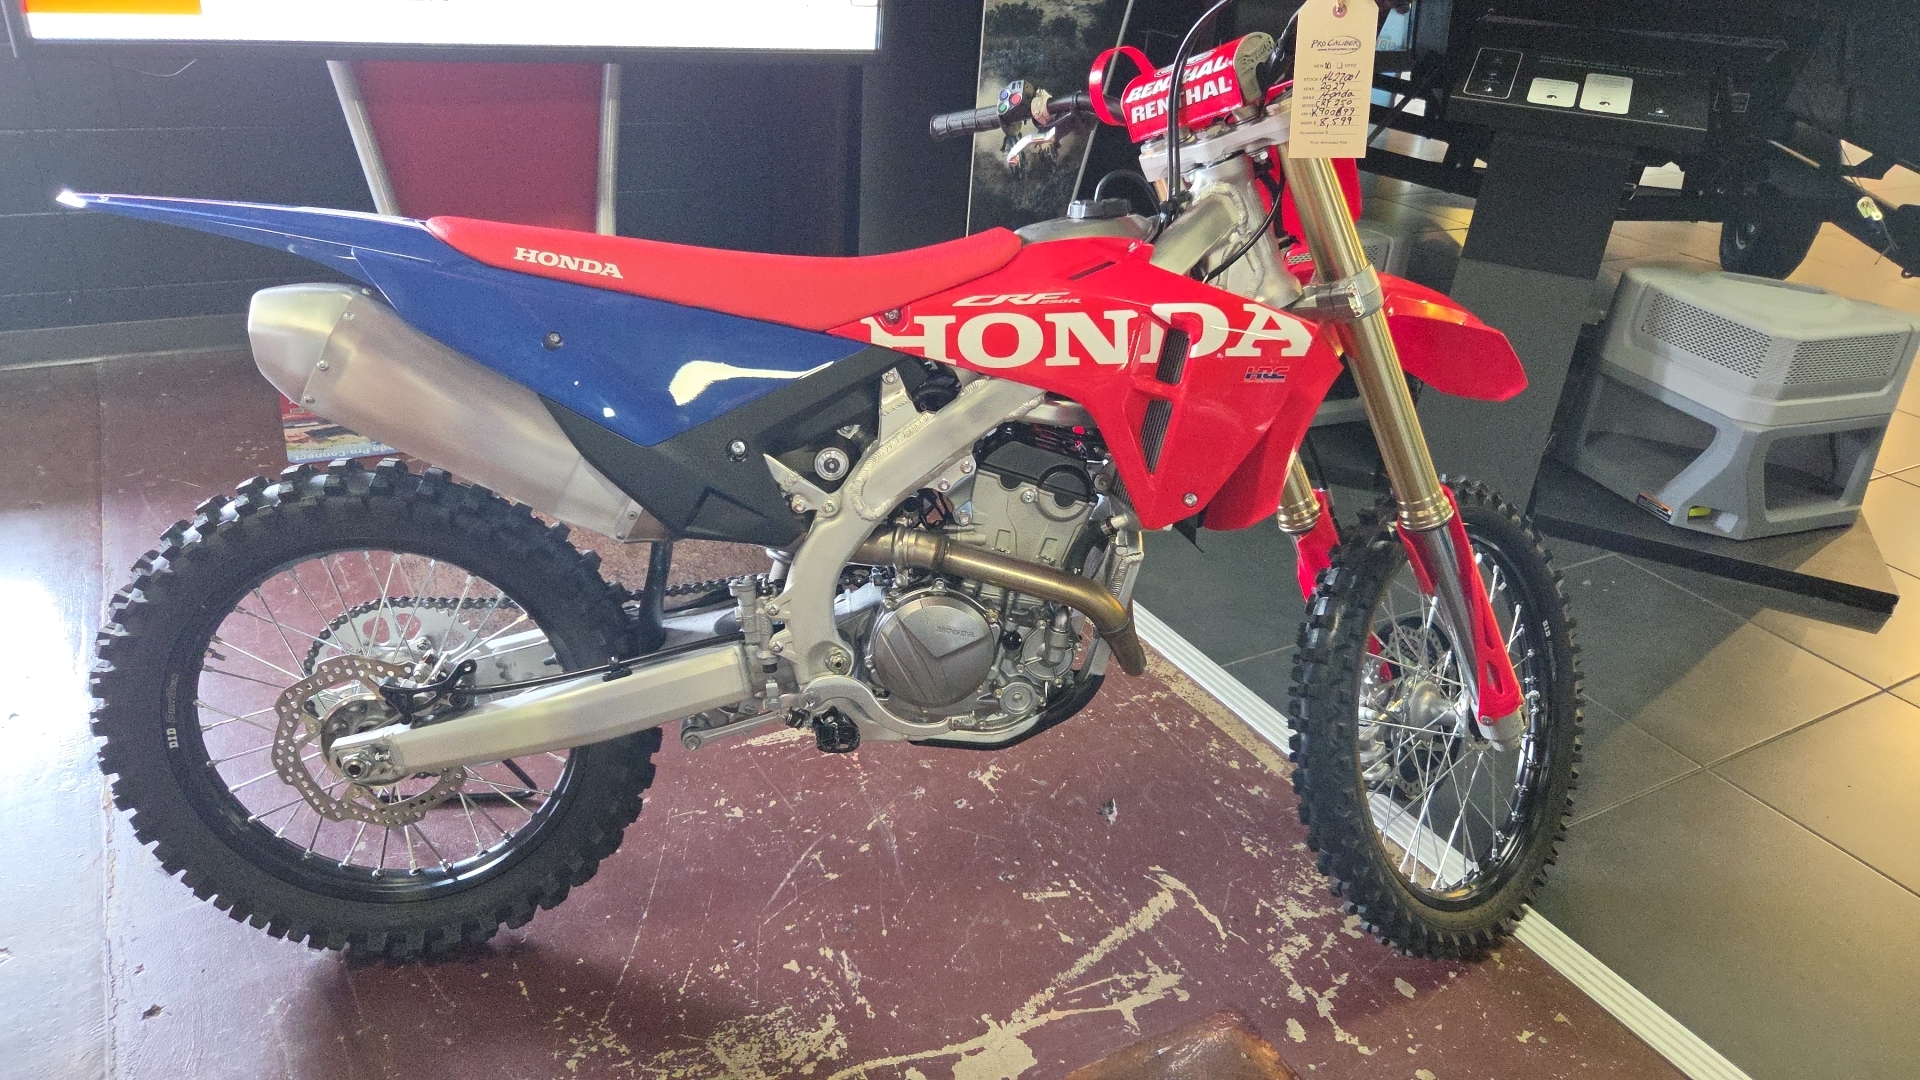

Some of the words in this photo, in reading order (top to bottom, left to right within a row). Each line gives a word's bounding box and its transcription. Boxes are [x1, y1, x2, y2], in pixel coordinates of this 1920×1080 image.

[1311, 39, 1326, 48] PRO
[1327, 38, 1359, 47] CALIBER
[514, 247, 624, 279] HONDA
[952, 291, 1071, 307] CRF
[860, 303, 1313, 367] HONDA
